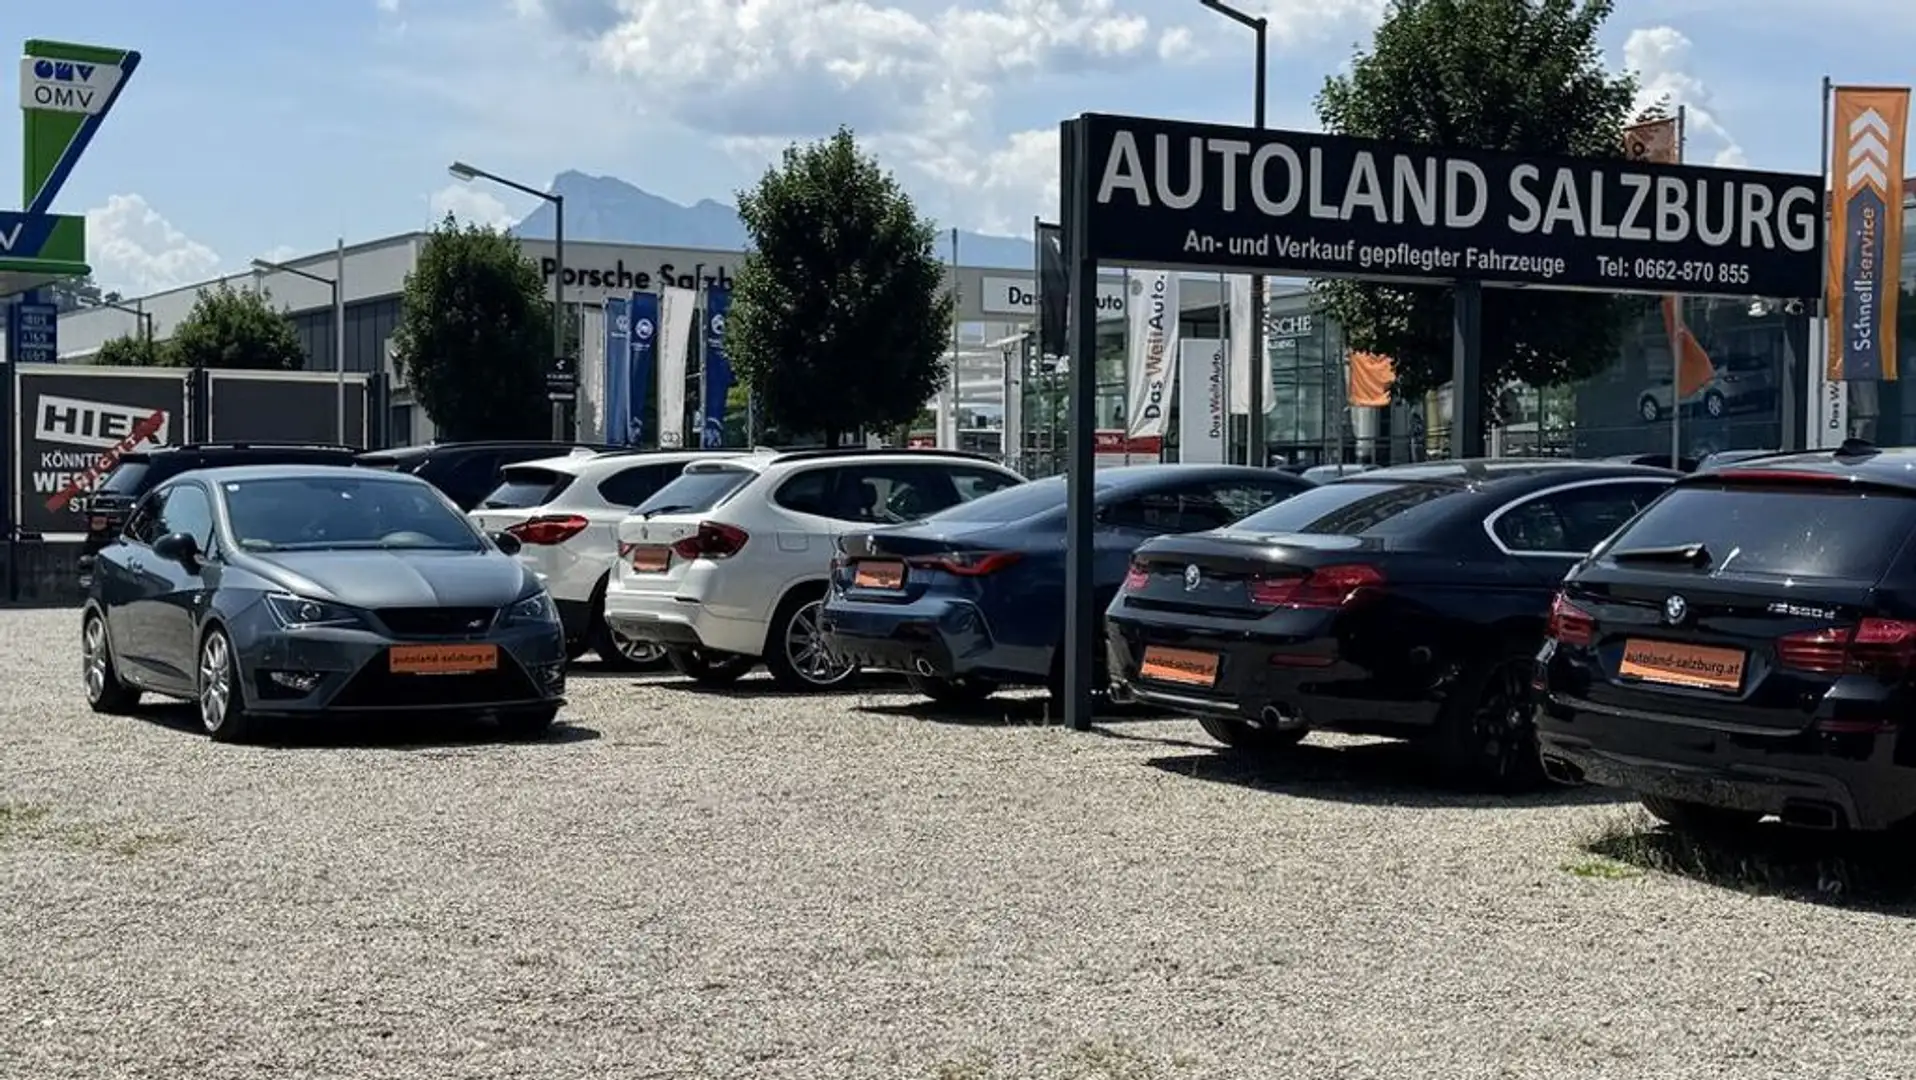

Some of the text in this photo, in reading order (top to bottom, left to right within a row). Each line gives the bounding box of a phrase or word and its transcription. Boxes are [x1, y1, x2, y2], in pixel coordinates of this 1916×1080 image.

[35, 86, 94, 108] OMV
[1097, 130, 1816, 251] AUTOLAND SALZBURG
[1184, 229, 1565, 278] An- und Verkauf gepflegter Fahrzeuge
[1597, 255, 1750, 284] Tel: 0662-870 855
[541, 257, 734, 292] Porsche Salzb
[1853, 207, 1875, 351] Schnellservice
[1008, 286, 1035, 305] Da
[1269, 315, 1313, 334] SCHE
[1144, 381, 1164, 419] Das
[1626, 652, 1740, 677] autoland-salzburg.at
